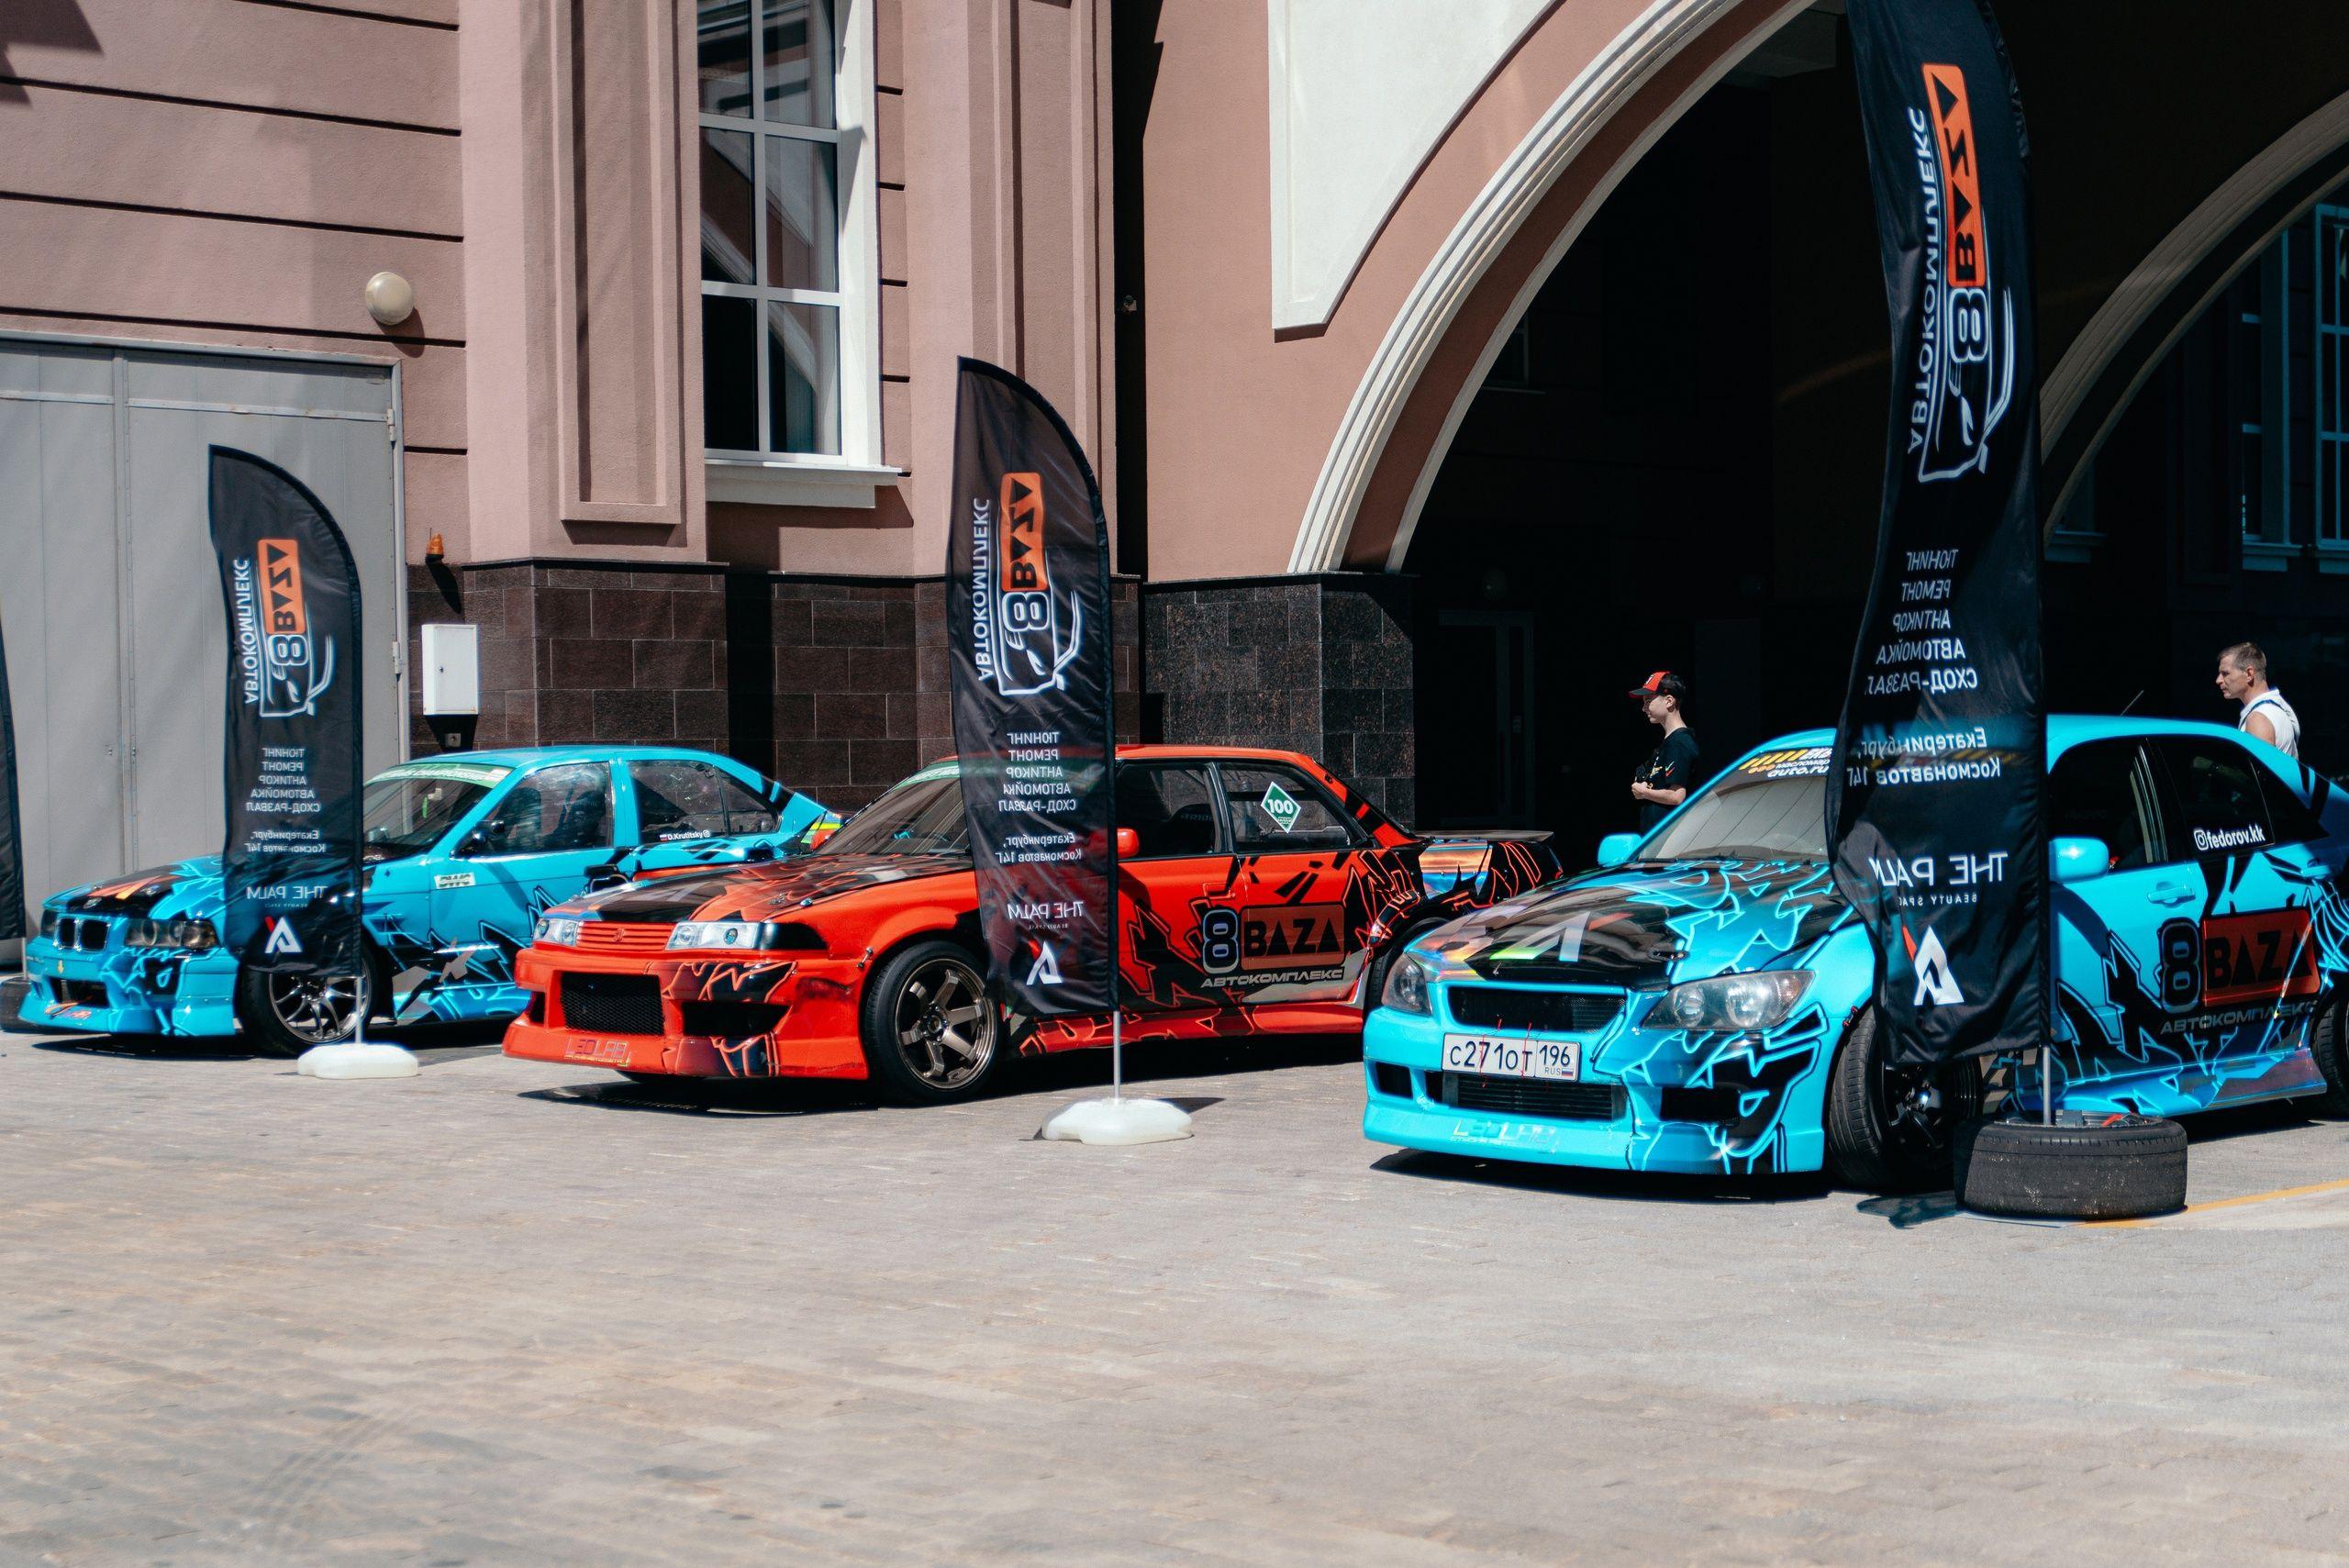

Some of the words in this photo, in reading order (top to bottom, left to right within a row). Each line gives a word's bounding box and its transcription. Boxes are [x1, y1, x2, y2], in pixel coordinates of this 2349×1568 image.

[1267, 799, 1294, 814] 100
[1202, 909, 1239, 973] 8
[1244, 917, 1341, 957] BAZA
[2161, 922, 2200, 1014] 8
[2206, 929, 2312, 989] BAZA
[1200, 969, 1343, 988] АВТОКОМПЛЕКС
[1539, 1045, 1571, 1067] 196
[1544, 1067, 1561, 1075] RUS
